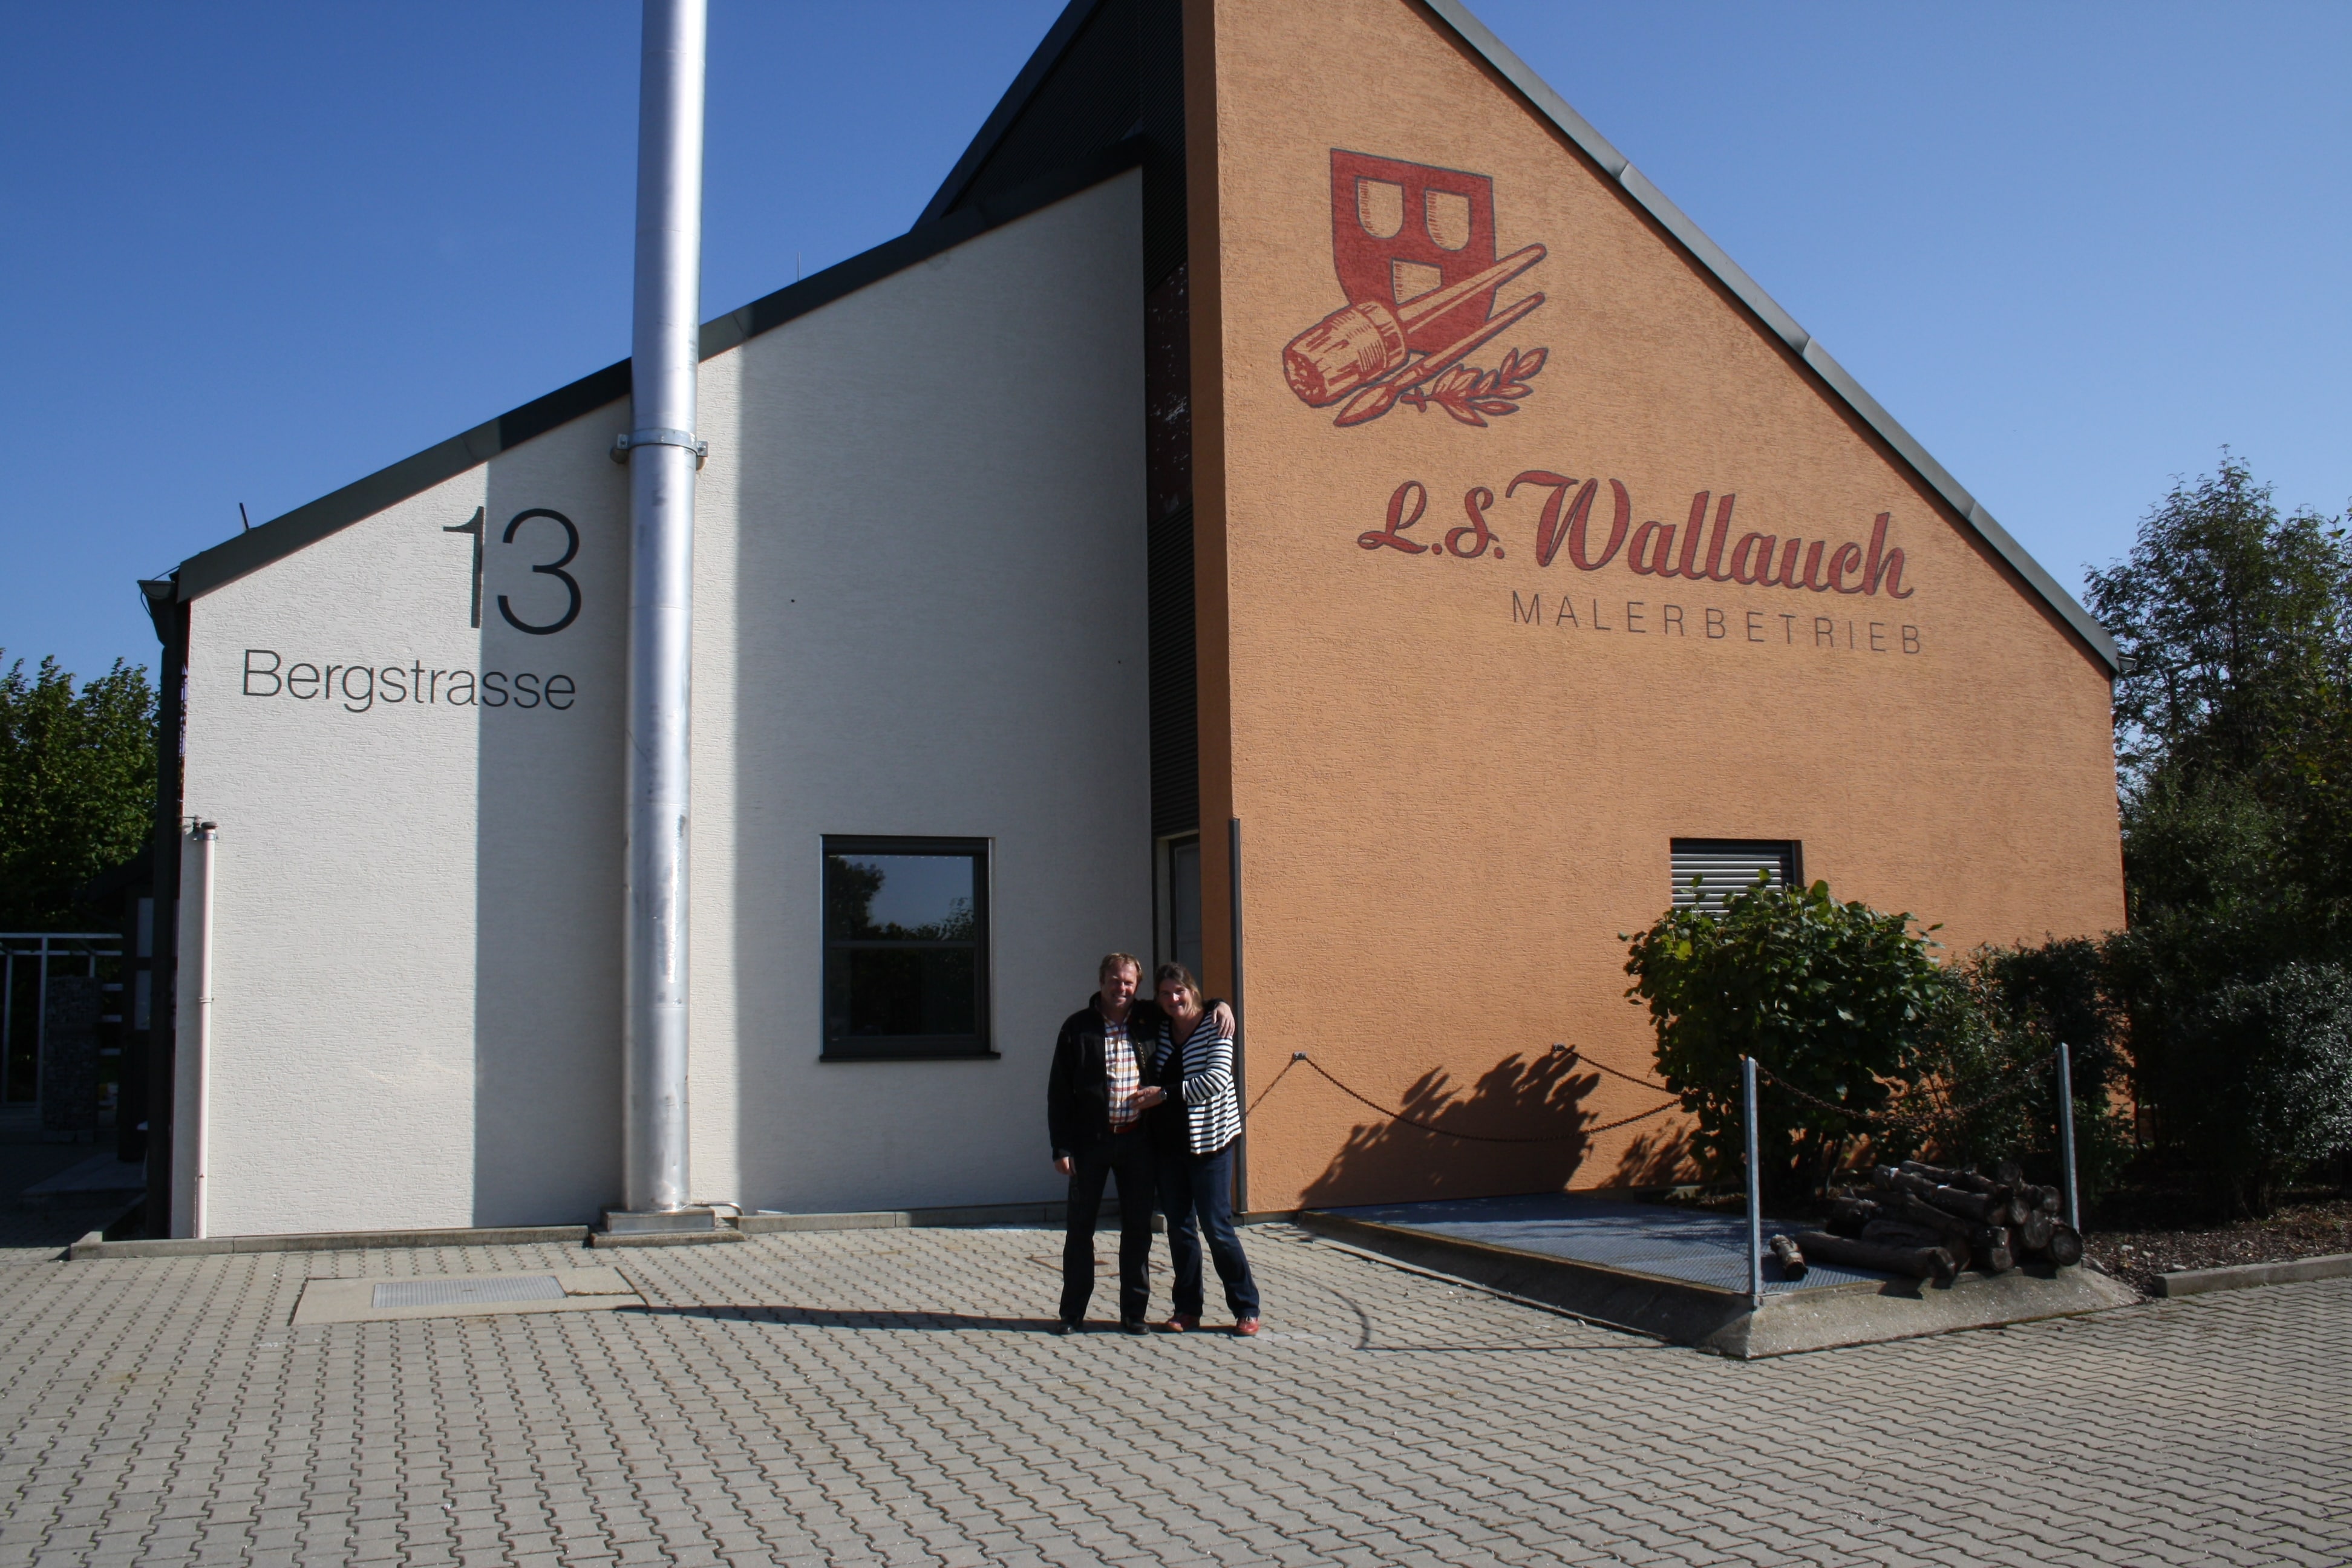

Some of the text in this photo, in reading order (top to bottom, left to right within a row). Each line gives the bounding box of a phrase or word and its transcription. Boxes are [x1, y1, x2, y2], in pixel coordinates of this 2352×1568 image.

[443, 506, 581, 635] 13
[1505, 469, 1915, 599] Wallauch
[1512, 590, 1920, 654] MALERBETRIEB
[242, 648, 576, 713] Bergstrasse
